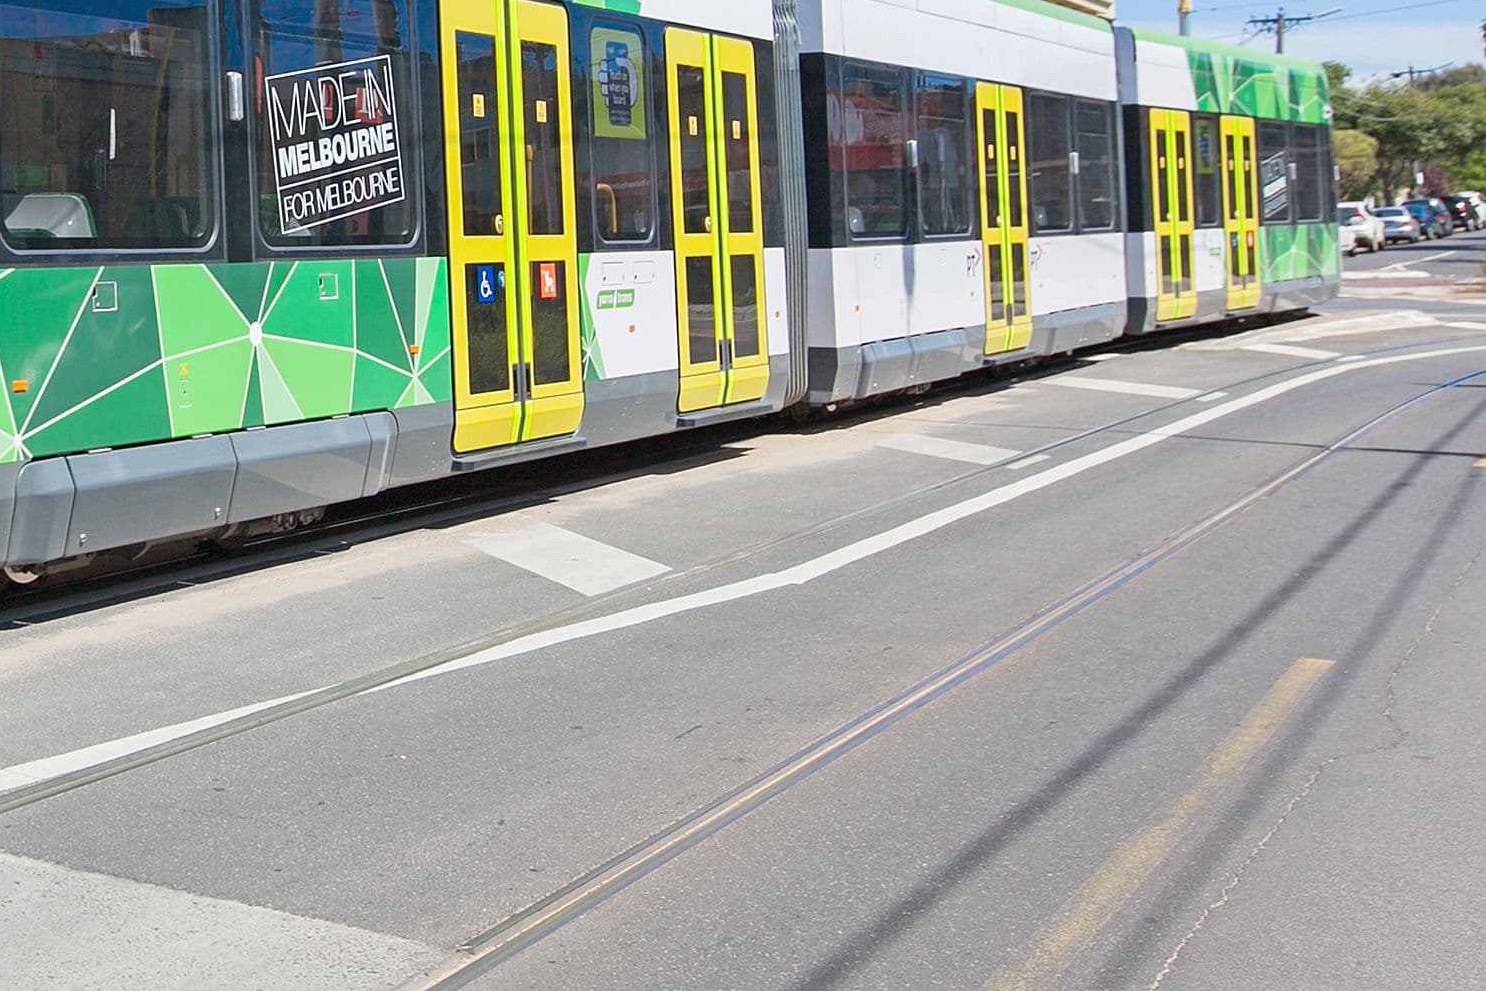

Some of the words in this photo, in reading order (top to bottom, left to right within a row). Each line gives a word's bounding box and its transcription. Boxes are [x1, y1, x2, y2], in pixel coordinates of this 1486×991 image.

[271, 71, 362, 140] MADE
[364, 65, 392, 120] IN
[278, 121, 396, 179] MELBOURNE
[283, 190, 316, 223] FOR
[316, 167, 400, 214] MELBOURNE
